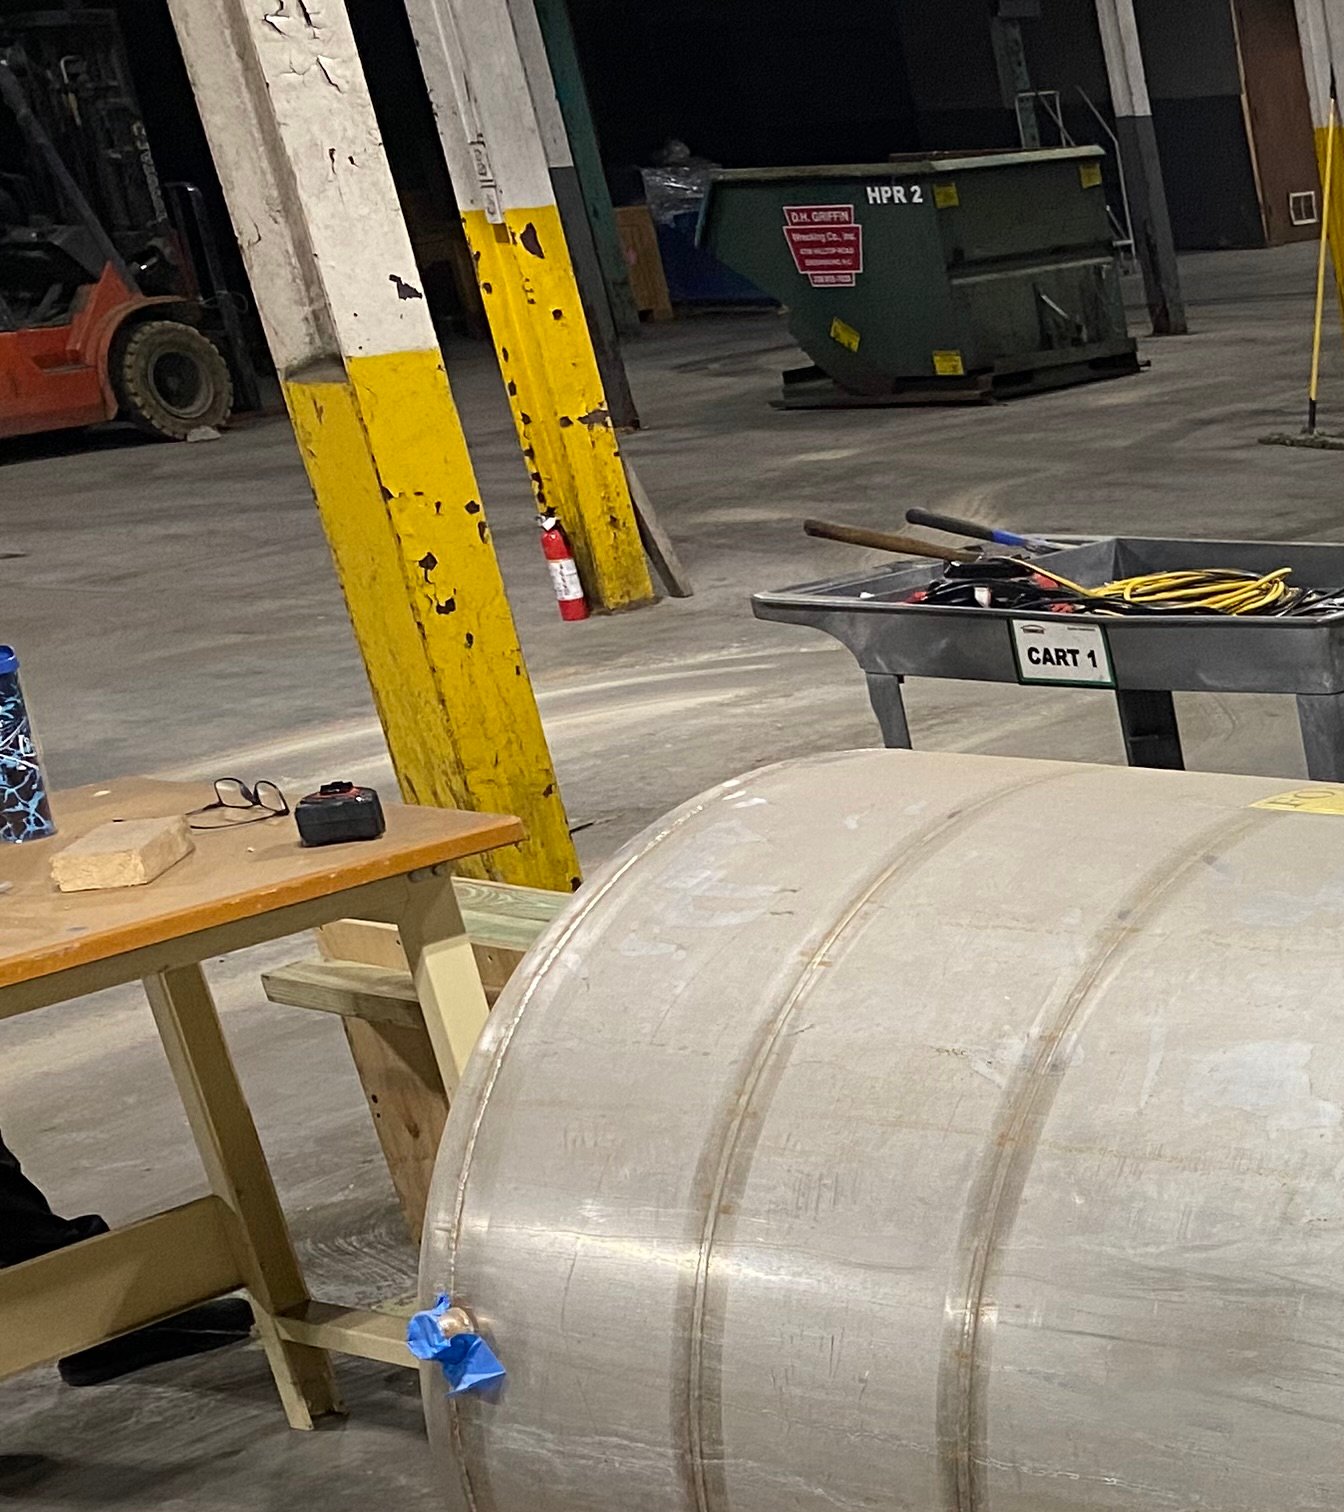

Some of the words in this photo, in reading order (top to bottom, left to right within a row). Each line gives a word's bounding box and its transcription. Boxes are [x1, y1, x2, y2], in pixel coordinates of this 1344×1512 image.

[866, 186, 907, 204] HPR
[910, 185, 923, 203] 2
[1027, 646, 1080, 667] CART
[1087, 650, 1097, 668] 1
